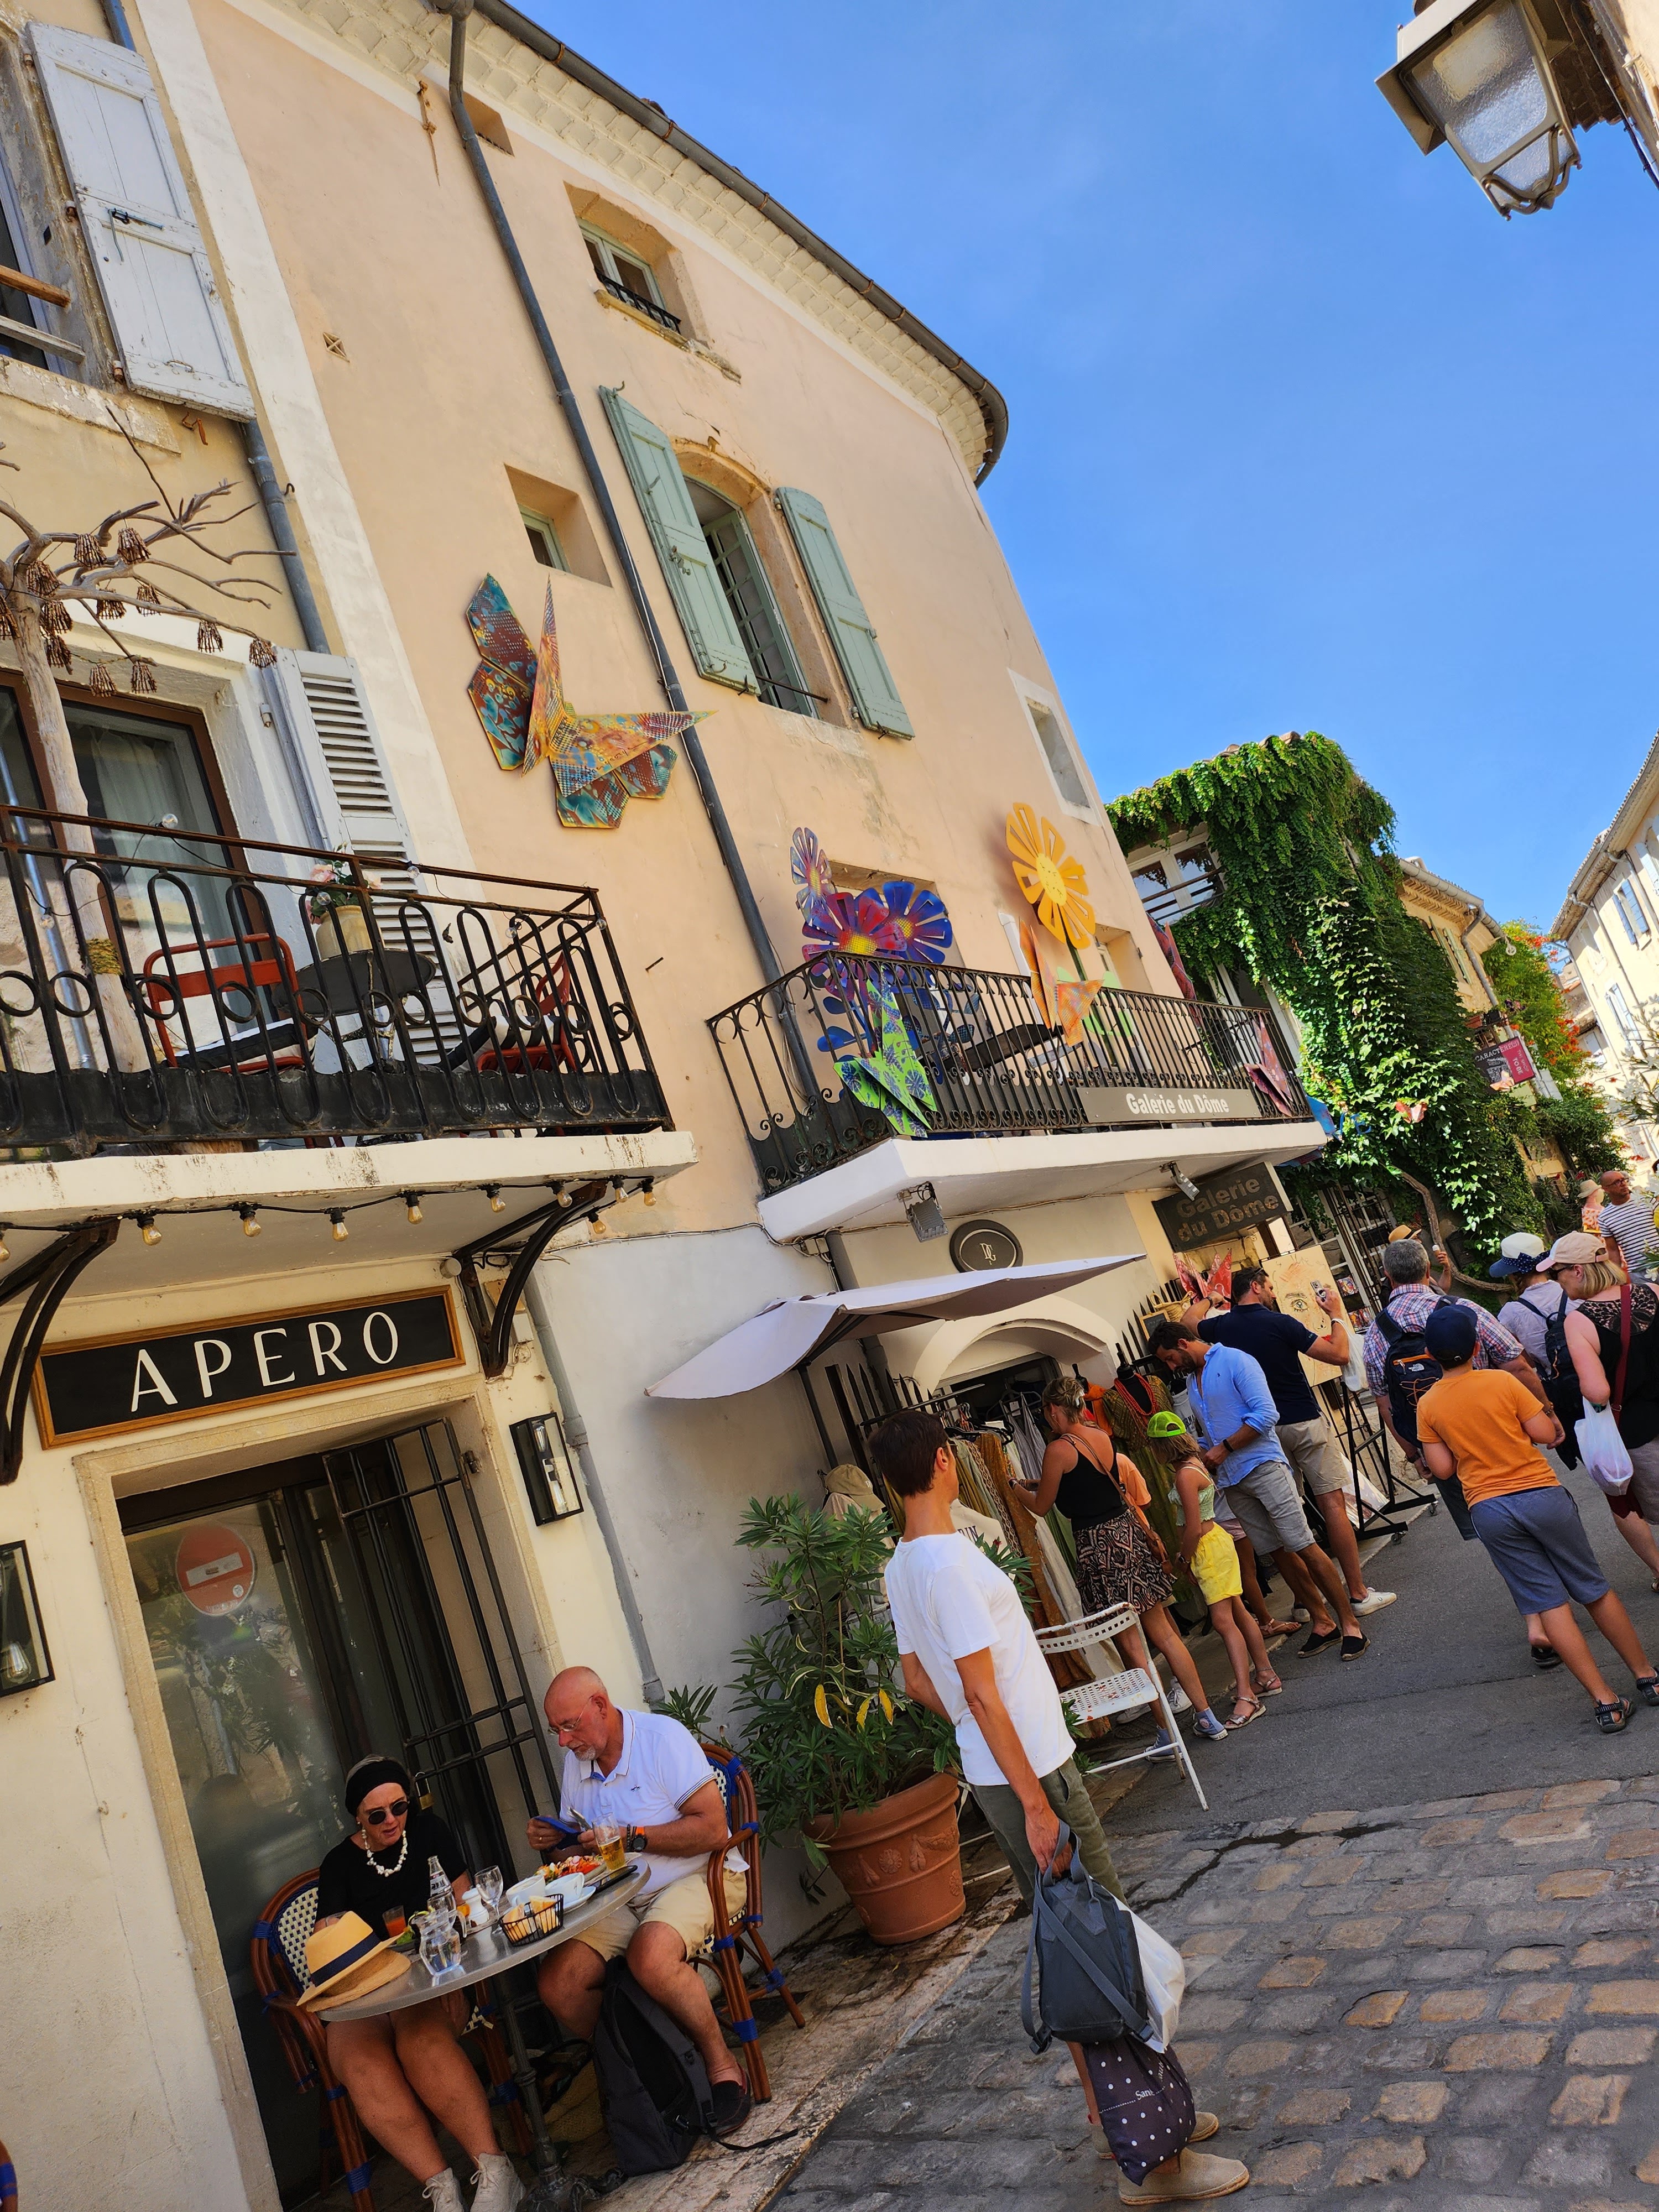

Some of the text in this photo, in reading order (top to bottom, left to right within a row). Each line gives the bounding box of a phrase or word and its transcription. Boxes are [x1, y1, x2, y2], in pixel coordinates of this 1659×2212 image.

[1512, 1057, 1523, 1075] TO BE
[1126, 1093, 1229, 1114] Galerie du Dôme
[1176, 1178, 1260, 1219] Galerie
[1178, 1195, 1279, 1242] du Dôme
[132, 1312, 398, 1412] APERO
